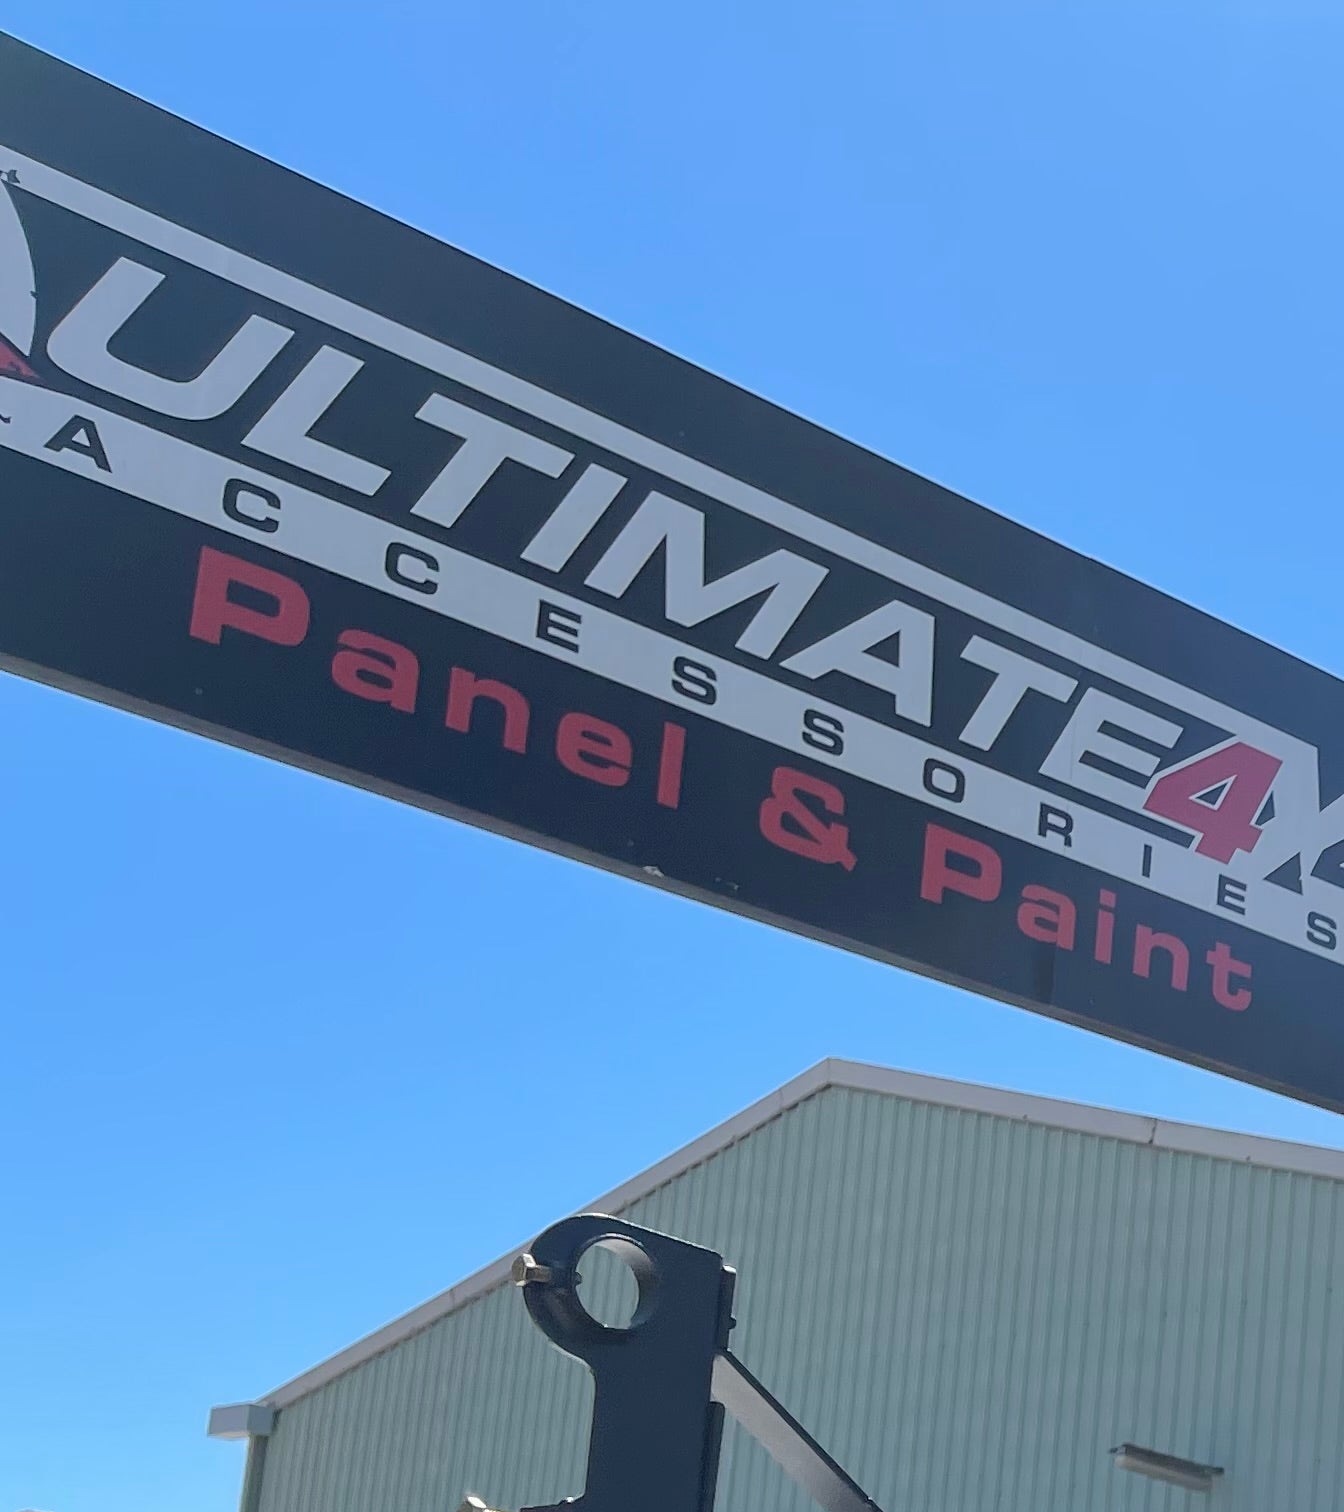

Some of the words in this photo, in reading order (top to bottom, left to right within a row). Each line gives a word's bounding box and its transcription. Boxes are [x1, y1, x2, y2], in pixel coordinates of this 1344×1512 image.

[44, 414, 1338, 951] ACCESSORIES
[189, 545, 687, 810] Panel
[759, 766, 857, 872] &
[919, 824, 1253, 1012] Paint
